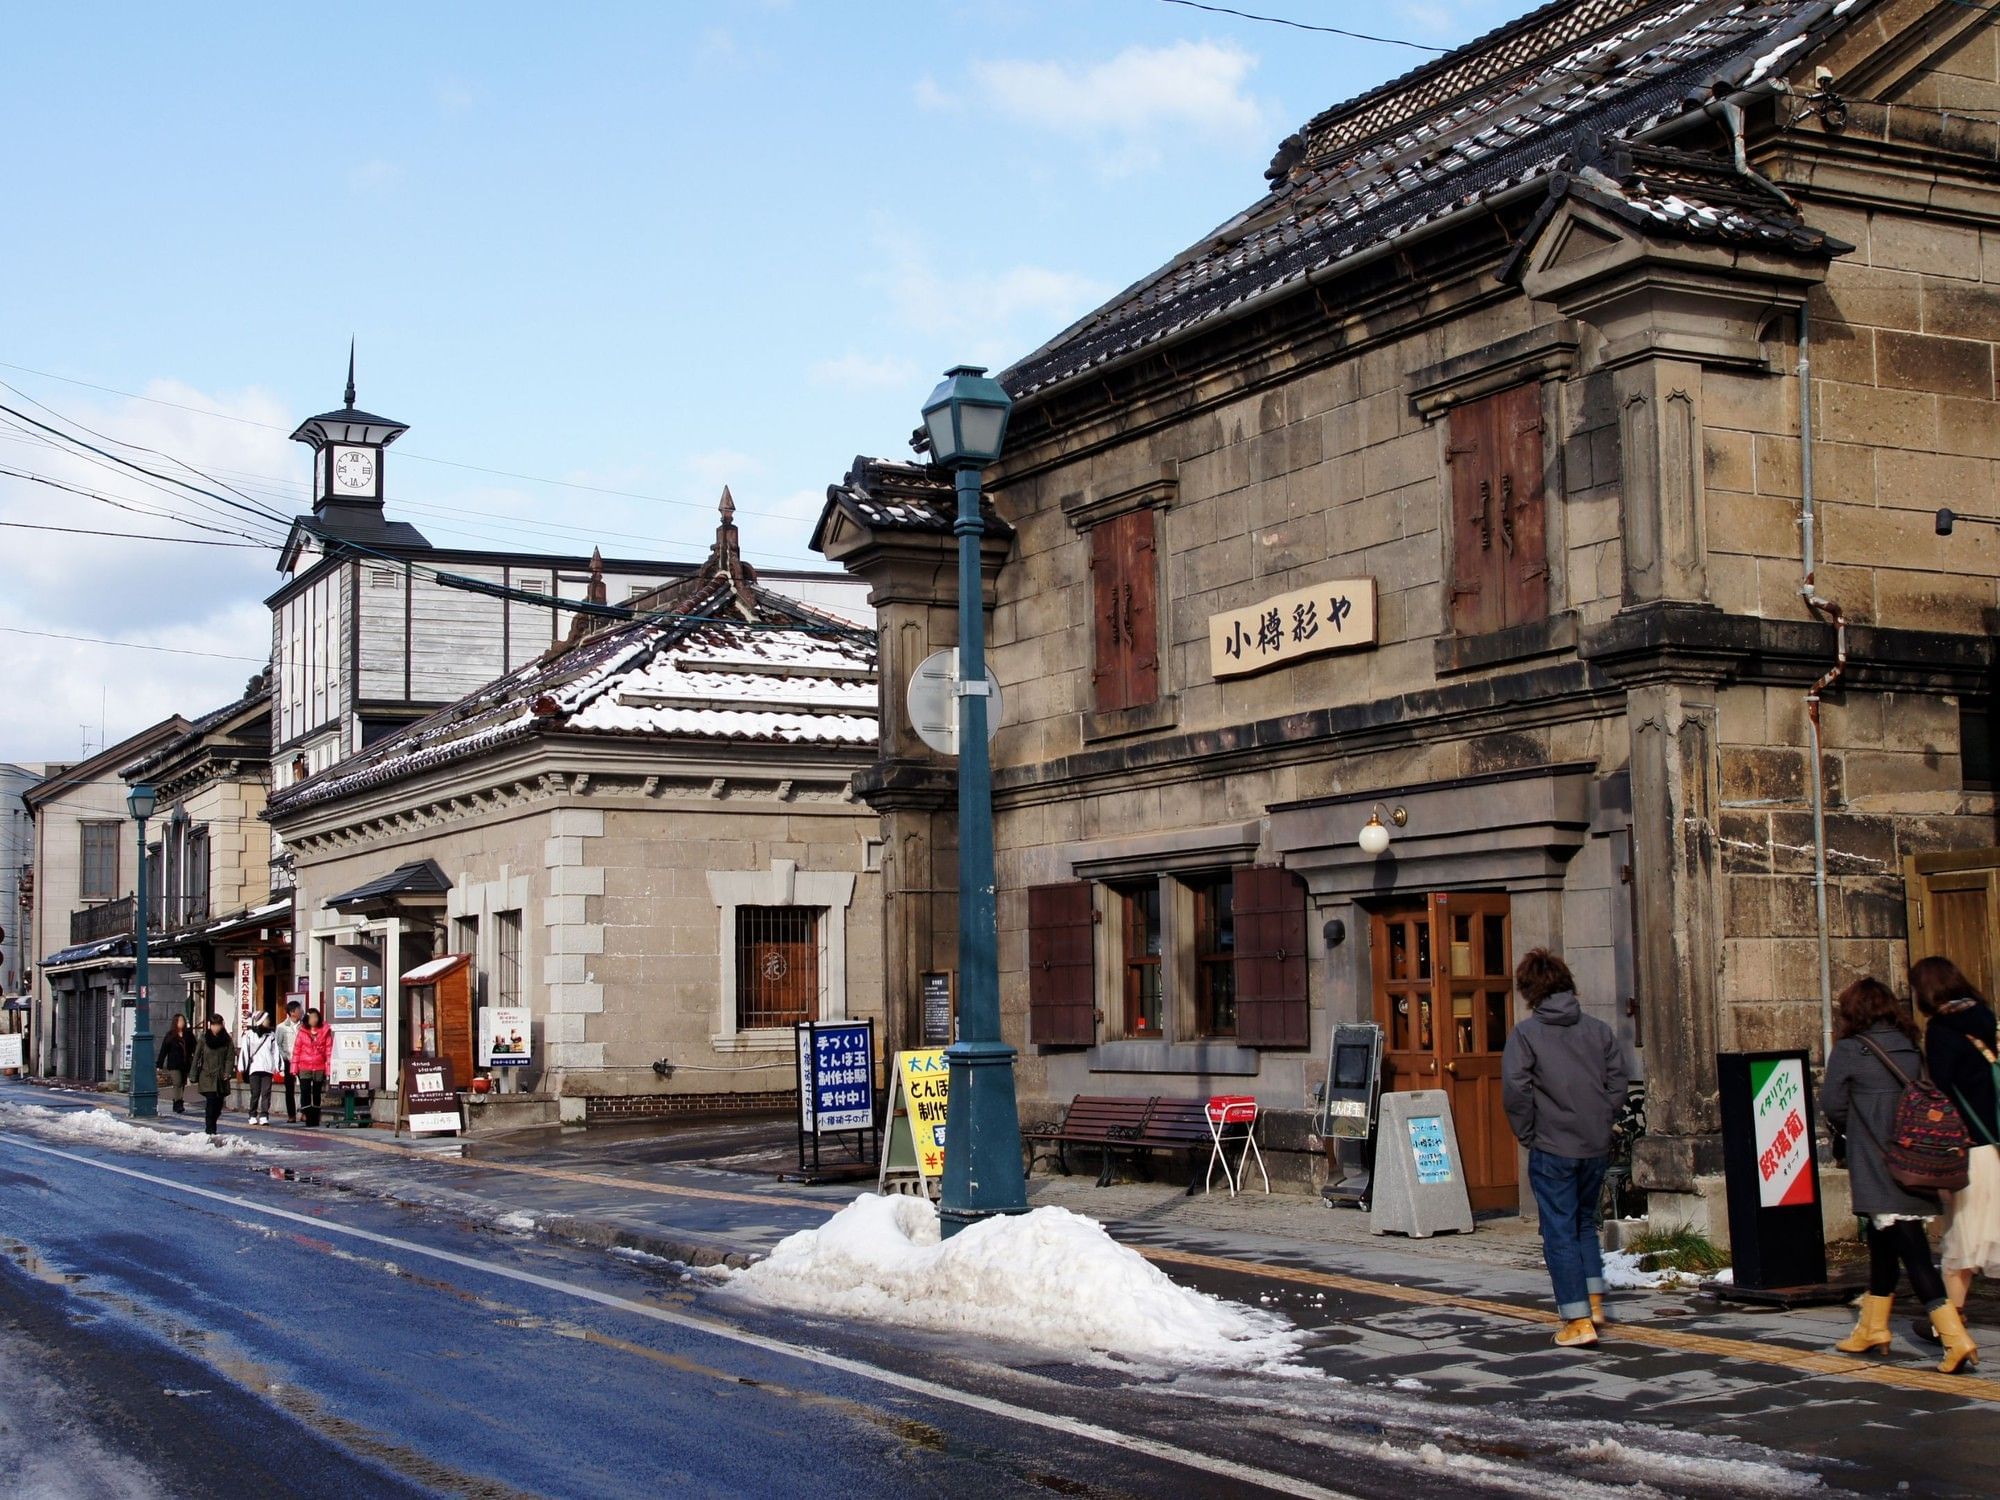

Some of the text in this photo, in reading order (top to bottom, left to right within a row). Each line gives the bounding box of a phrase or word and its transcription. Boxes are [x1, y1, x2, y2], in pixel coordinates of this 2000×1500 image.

[1225, 595, 1352, 660] 小樽彩や
[816, 1034, 864, 1050] 手づくり
[819, 1051, 866, 1068] とんぼ玉
[818, 1068, 867, 1086] 制作体験
[821, 1089, 866, 1107] 受付中!
[1759, 1072, 1790, 1117] イタリアン
[1778, 1083, 1798, 1111] カフェ
[918, 1101, 948, 1121] 制作
